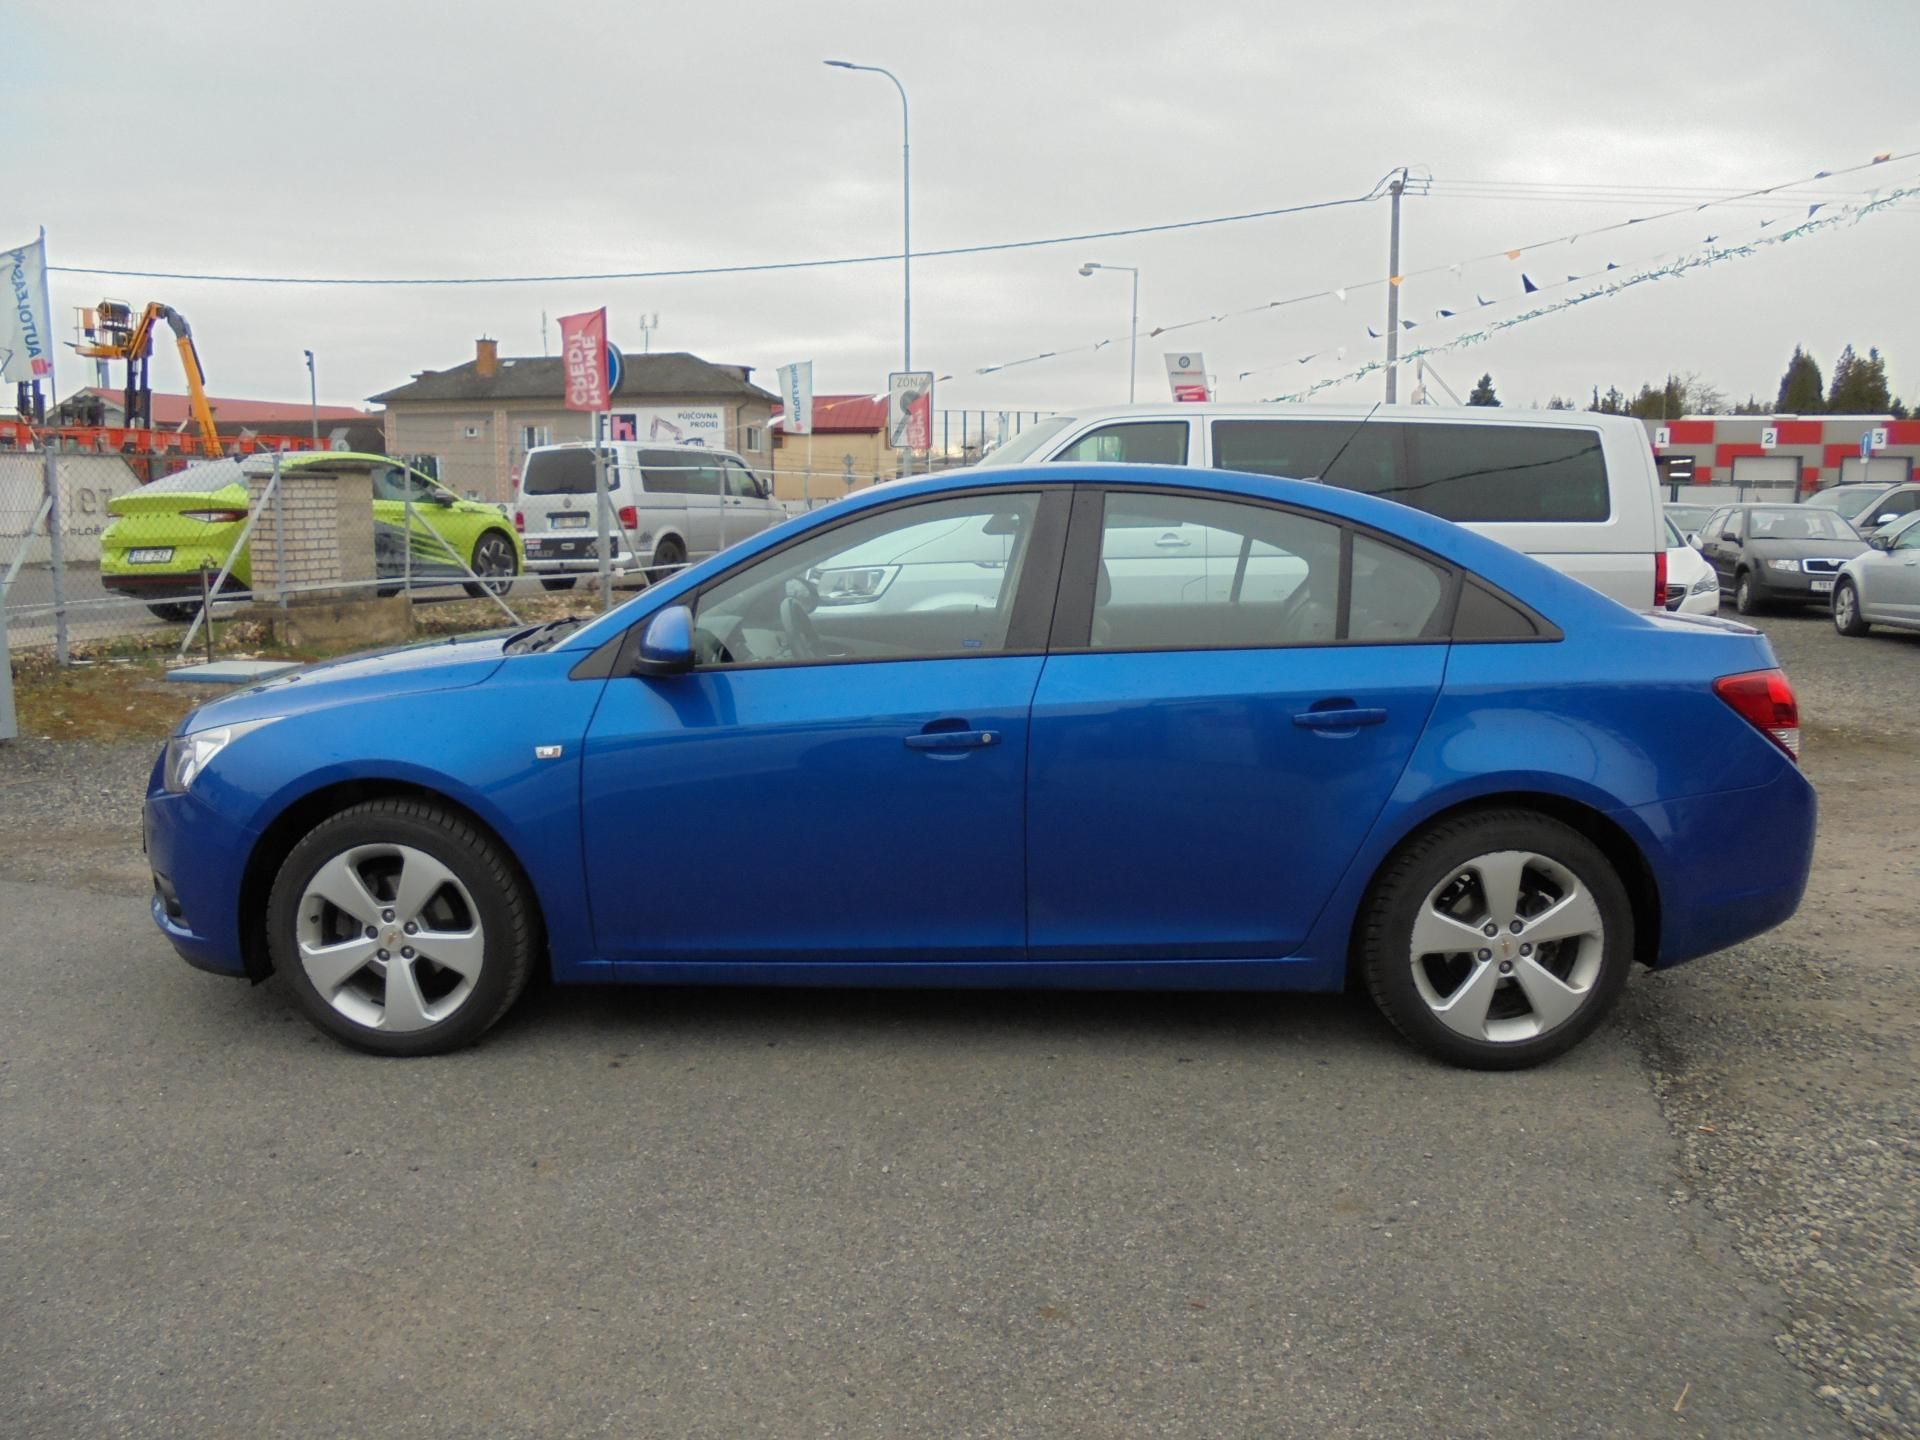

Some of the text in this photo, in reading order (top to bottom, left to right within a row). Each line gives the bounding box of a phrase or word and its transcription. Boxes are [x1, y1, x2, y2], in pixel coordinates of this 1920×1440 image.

[690, 421, 718, 429] PRODEJ
[1659, 433, 1666, 443] 1
[1764, 433, 1774, 443] 2
[1874, 433, 1884, 444] 3
